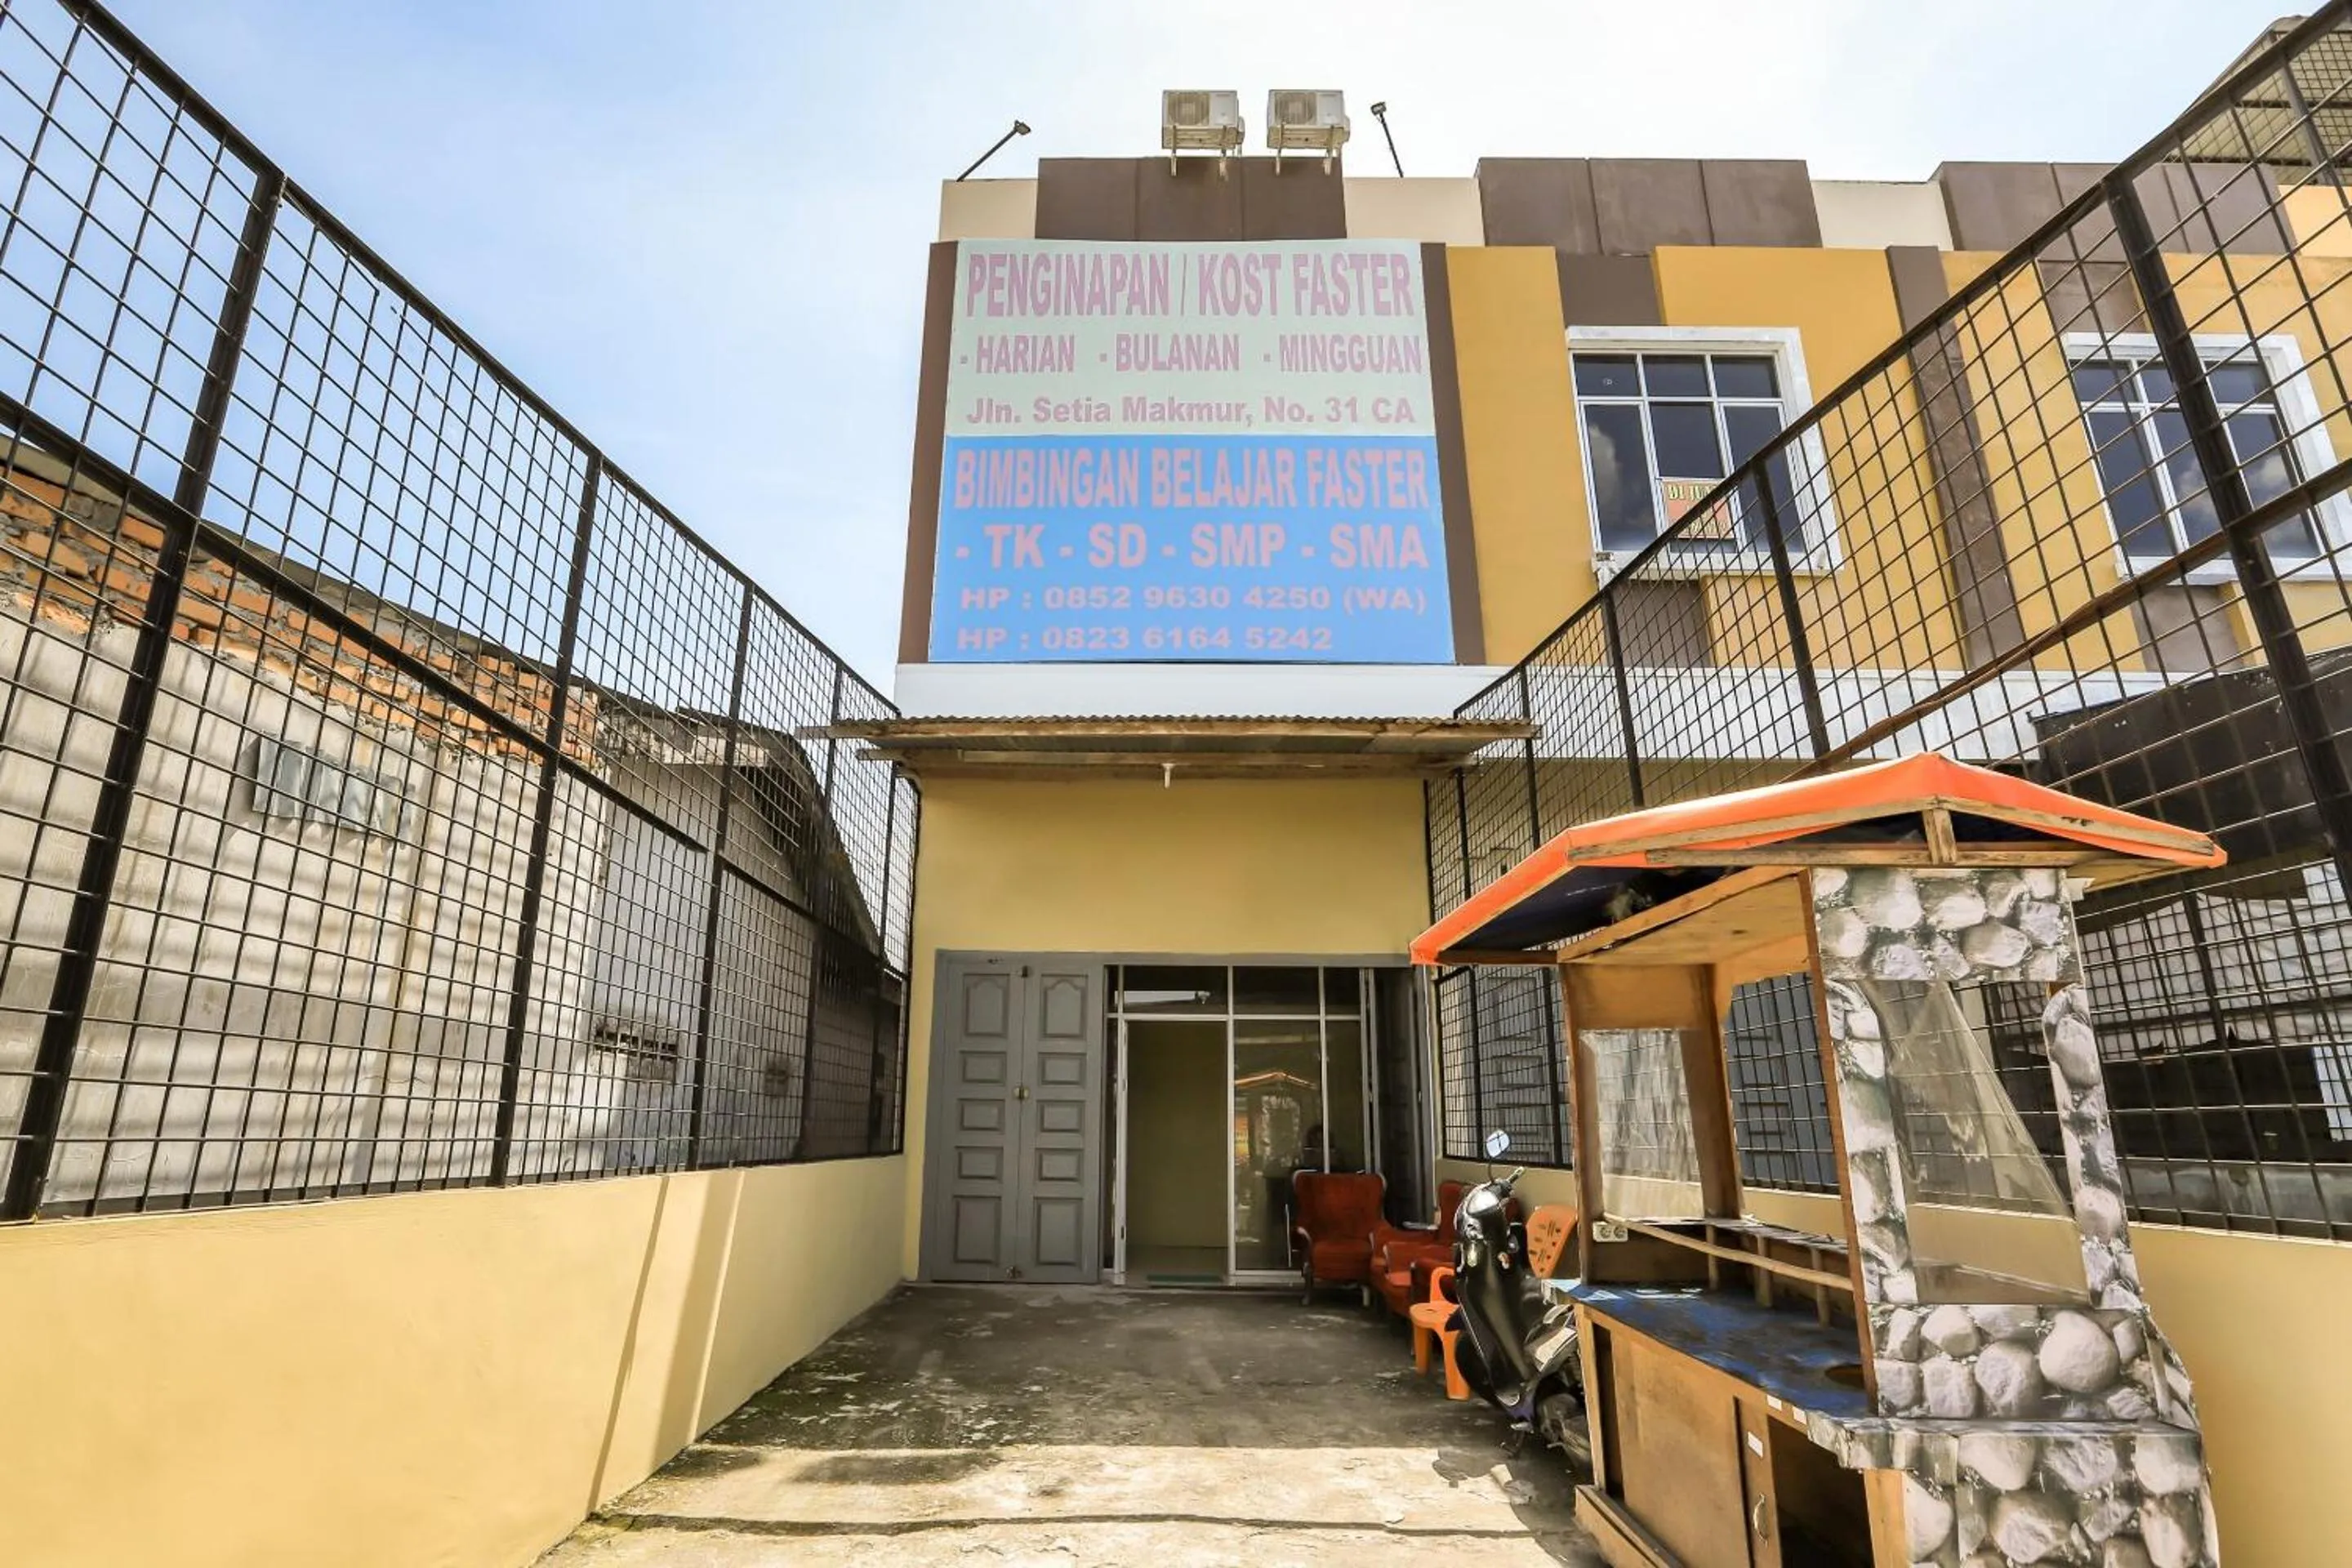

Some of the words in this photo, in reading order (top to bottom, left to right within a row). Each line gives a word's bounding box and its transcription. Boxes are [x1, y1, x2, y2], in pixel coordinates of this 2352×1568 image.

[966, 252, 1171, 318] PENGINAPAN
[1198, 252, 1282, 318] KOST
[1293, 252, 1414, 316] FASTER
[976, 333, 1076, 374] HARIAN
[1114, 332, 1241, 372] BULANAN
[1278, 333, 1423, 374] MINGGUAN
[966, 398, 1021, 425] Jln.
[1032, 395, 1111, 424] Setia
[1121, 395, 1254, 427] Makmur,
[1264, 397, 1315, 423] No.
[1325, 396, 1359, 423] 31
[1371, 397, 1416, 423] CA
[954, 448, 1140, 509] BIMBINGAN
[1151, 448, 1298, 509] BELAJAR
[1307, 449, 1429, 509] FASTER
[983, 524, 1045, 568] TK
[1087, 523, 1147, 568] SD
[1189, 523, 1287, 568] SMP
[1329, 523, 1430, 570] SMA
[960, 586, 1010, 610] HP
[1045, 586, 1132, 610] 0852
[1143, 586, 1230, 610] 9630
[1243, 585, 1331, 610] 4250
[1342, 586, 1429, 615] (WA)
[956, 626, 1009, 651] HP
[1041, 626, 1130, 651] 0823
[1142, 626, 1232, 650] 6164
[1244, 626, 1333, 651] 5242
